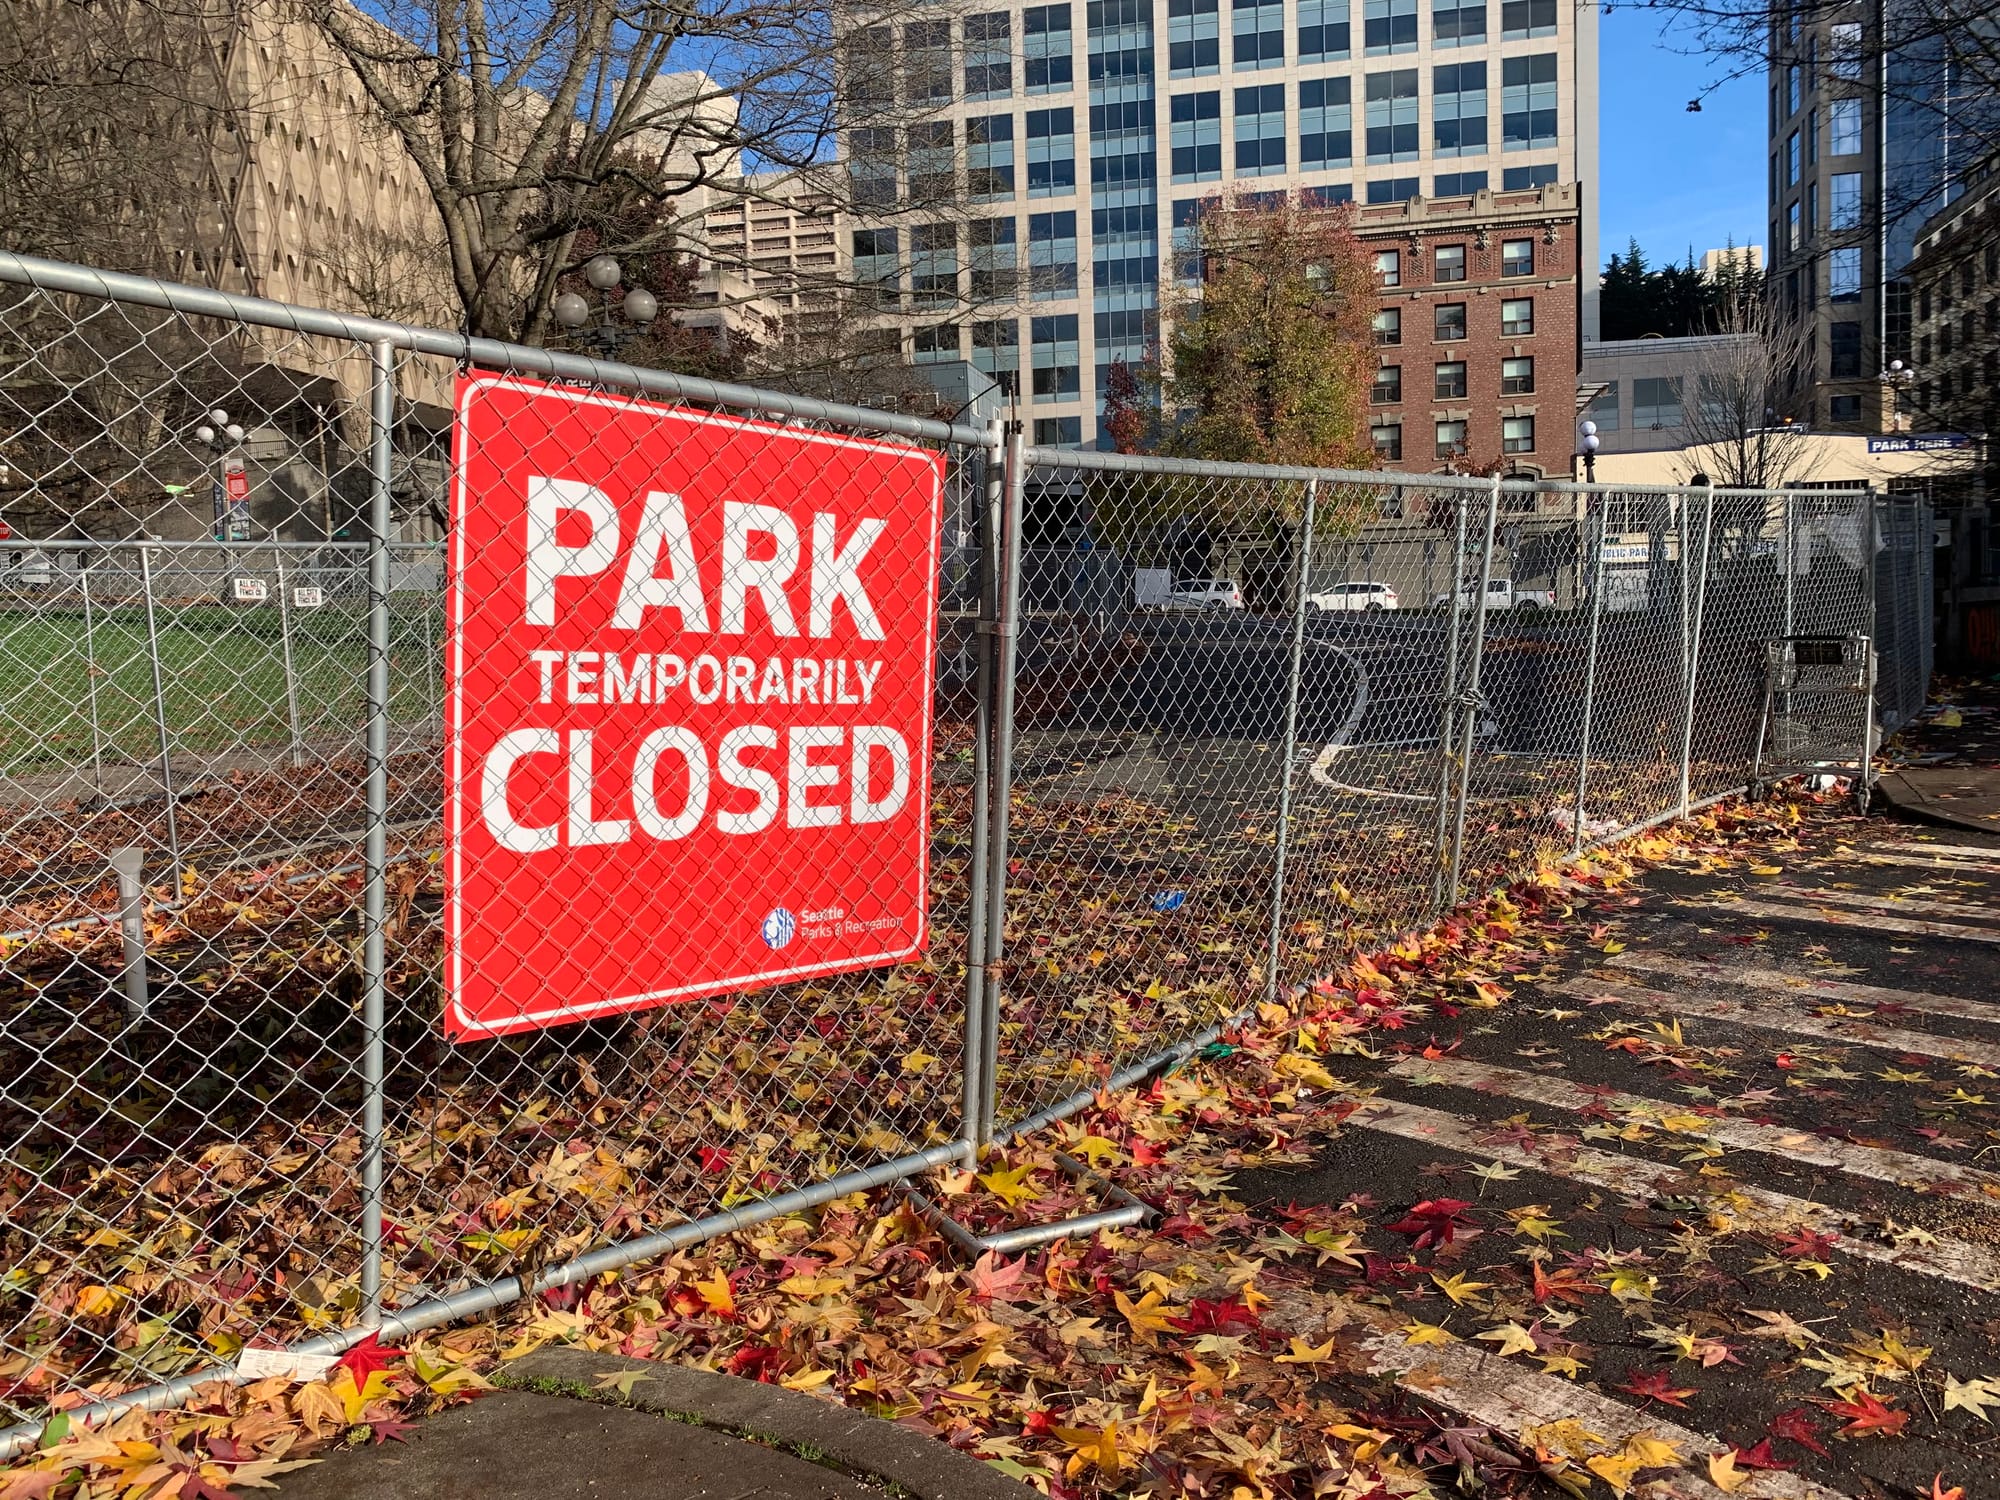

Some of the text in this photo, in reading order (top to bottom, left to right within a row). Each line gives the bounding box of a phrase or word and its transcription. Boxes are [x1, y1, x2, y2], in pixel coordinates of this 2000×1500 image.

[1872, 440, 1909, 451] PARK
[524, 475, 889, 641] PARK
[530, 650, 883, 705] TEMPORARILY
[481, 725, 910, 853] CLOSED
[801, 907, 844, 923] Seattle
[801, 925, 832, 939] Parks
[845, 917, 903, 934] Recreation
